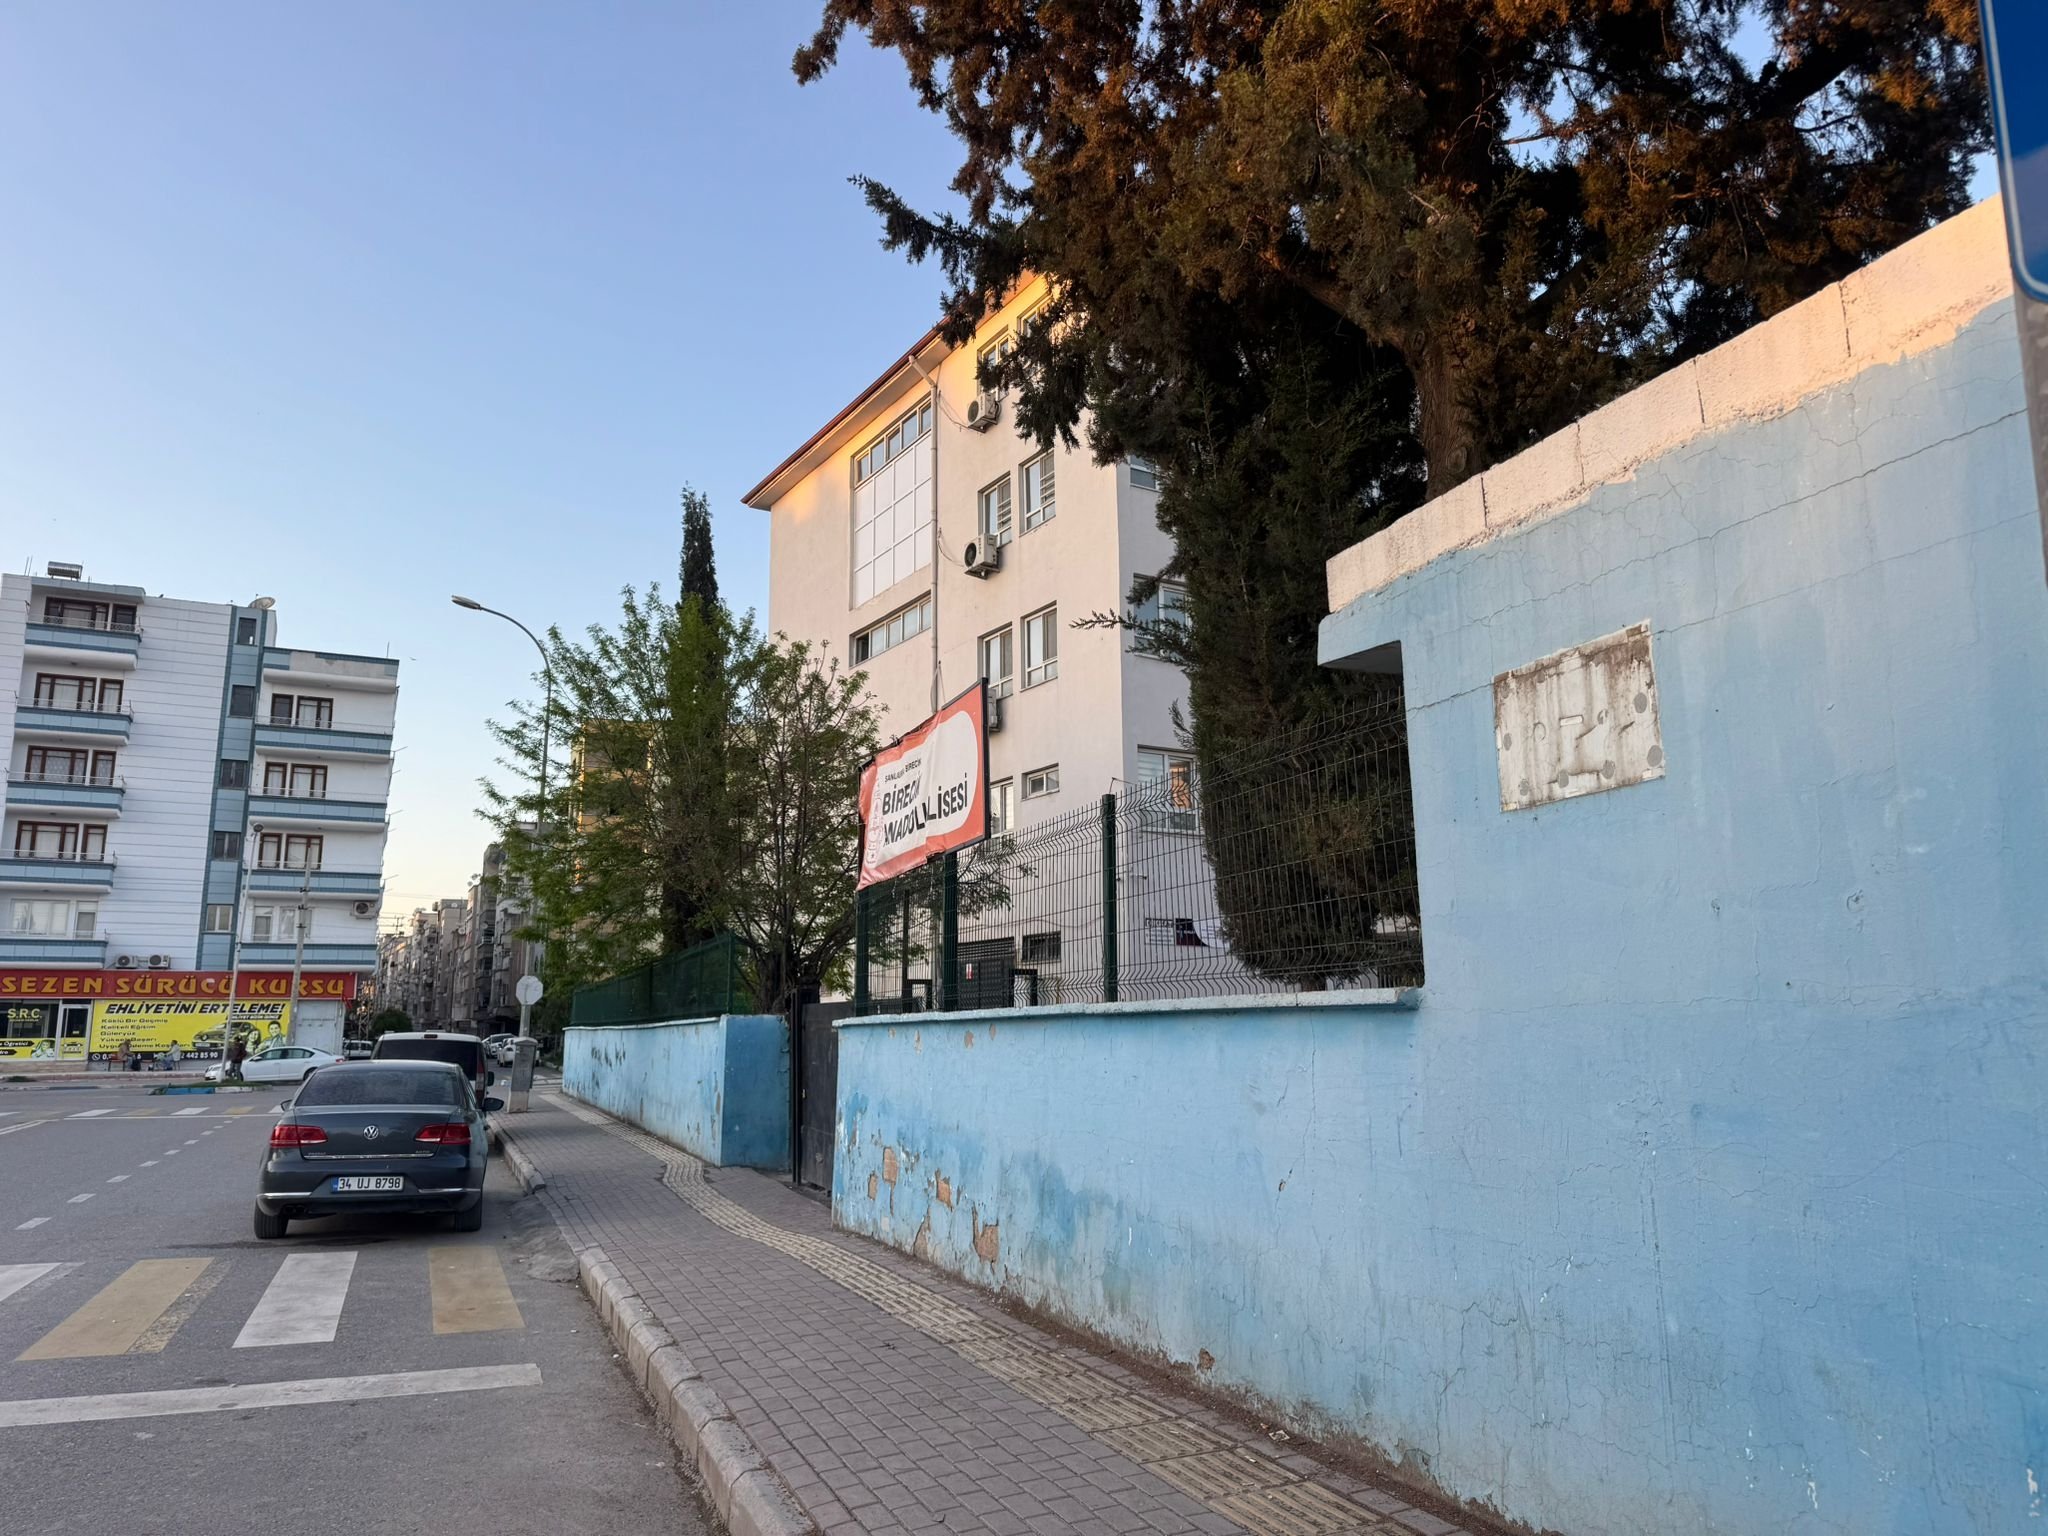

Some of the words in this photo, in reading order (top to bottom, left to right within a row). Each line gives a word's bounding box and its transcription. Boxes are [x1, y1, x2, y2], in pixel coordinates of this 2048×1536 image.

[926, 772, 968, 821] LİSESİ
[1, 976, 103, 994] SEZEN
[116, 974, 234, 995] SÜRÜCÜ
[249, 978, 344, 996] KURSU
[7, 1008, 43, 1019] S.R.C.
[105, 1001, 199, 1014] EHLİYETİNİ
[199, 1003, 286, 1014] ERTELEME!
[186, 1051, 199, 1059] 442
[209, 1051, 219, 1059] 90
[339, 1178, 352, 1189] 34
[357, 1178, 371, 1189] UJ
[375, 1177, 401, 1189] 8798
